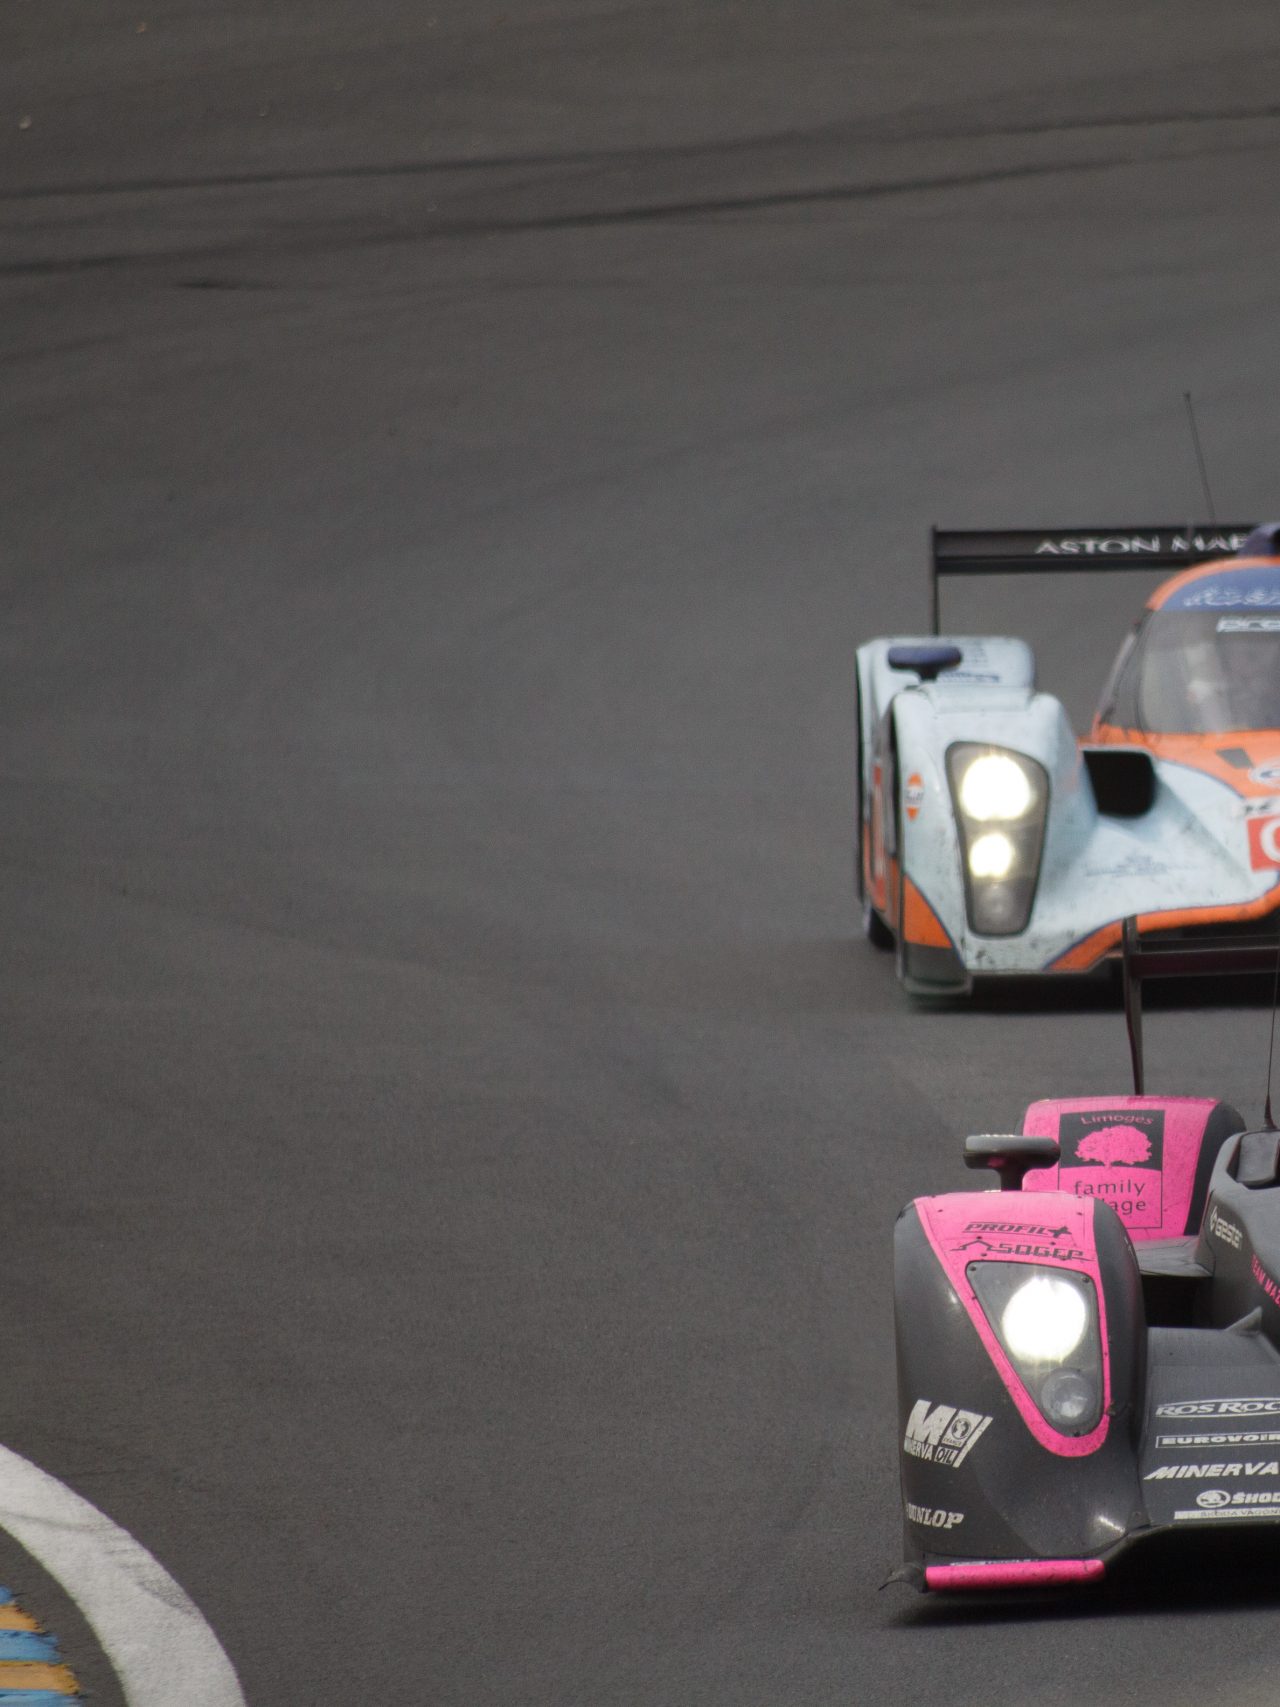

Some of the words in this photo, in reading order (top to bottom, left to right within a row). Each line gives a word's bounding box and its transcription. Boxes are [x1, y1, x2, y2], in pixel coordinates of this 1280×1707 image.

[1035, 535, 1161, 554] ASTON
[1081, 1114, 1153, 1125] Limoges
[1074, 1179, 1146, 1196] family
[1252, 1253, 1267, 1286] TEAM
[1156, 1404, 1215, 1416] ROS
[904, 1438, 933, 1461] ERVA
[934, 1446, 959, 1464] OIL
[1143, 1461, 1279, 1480] MINERVA
